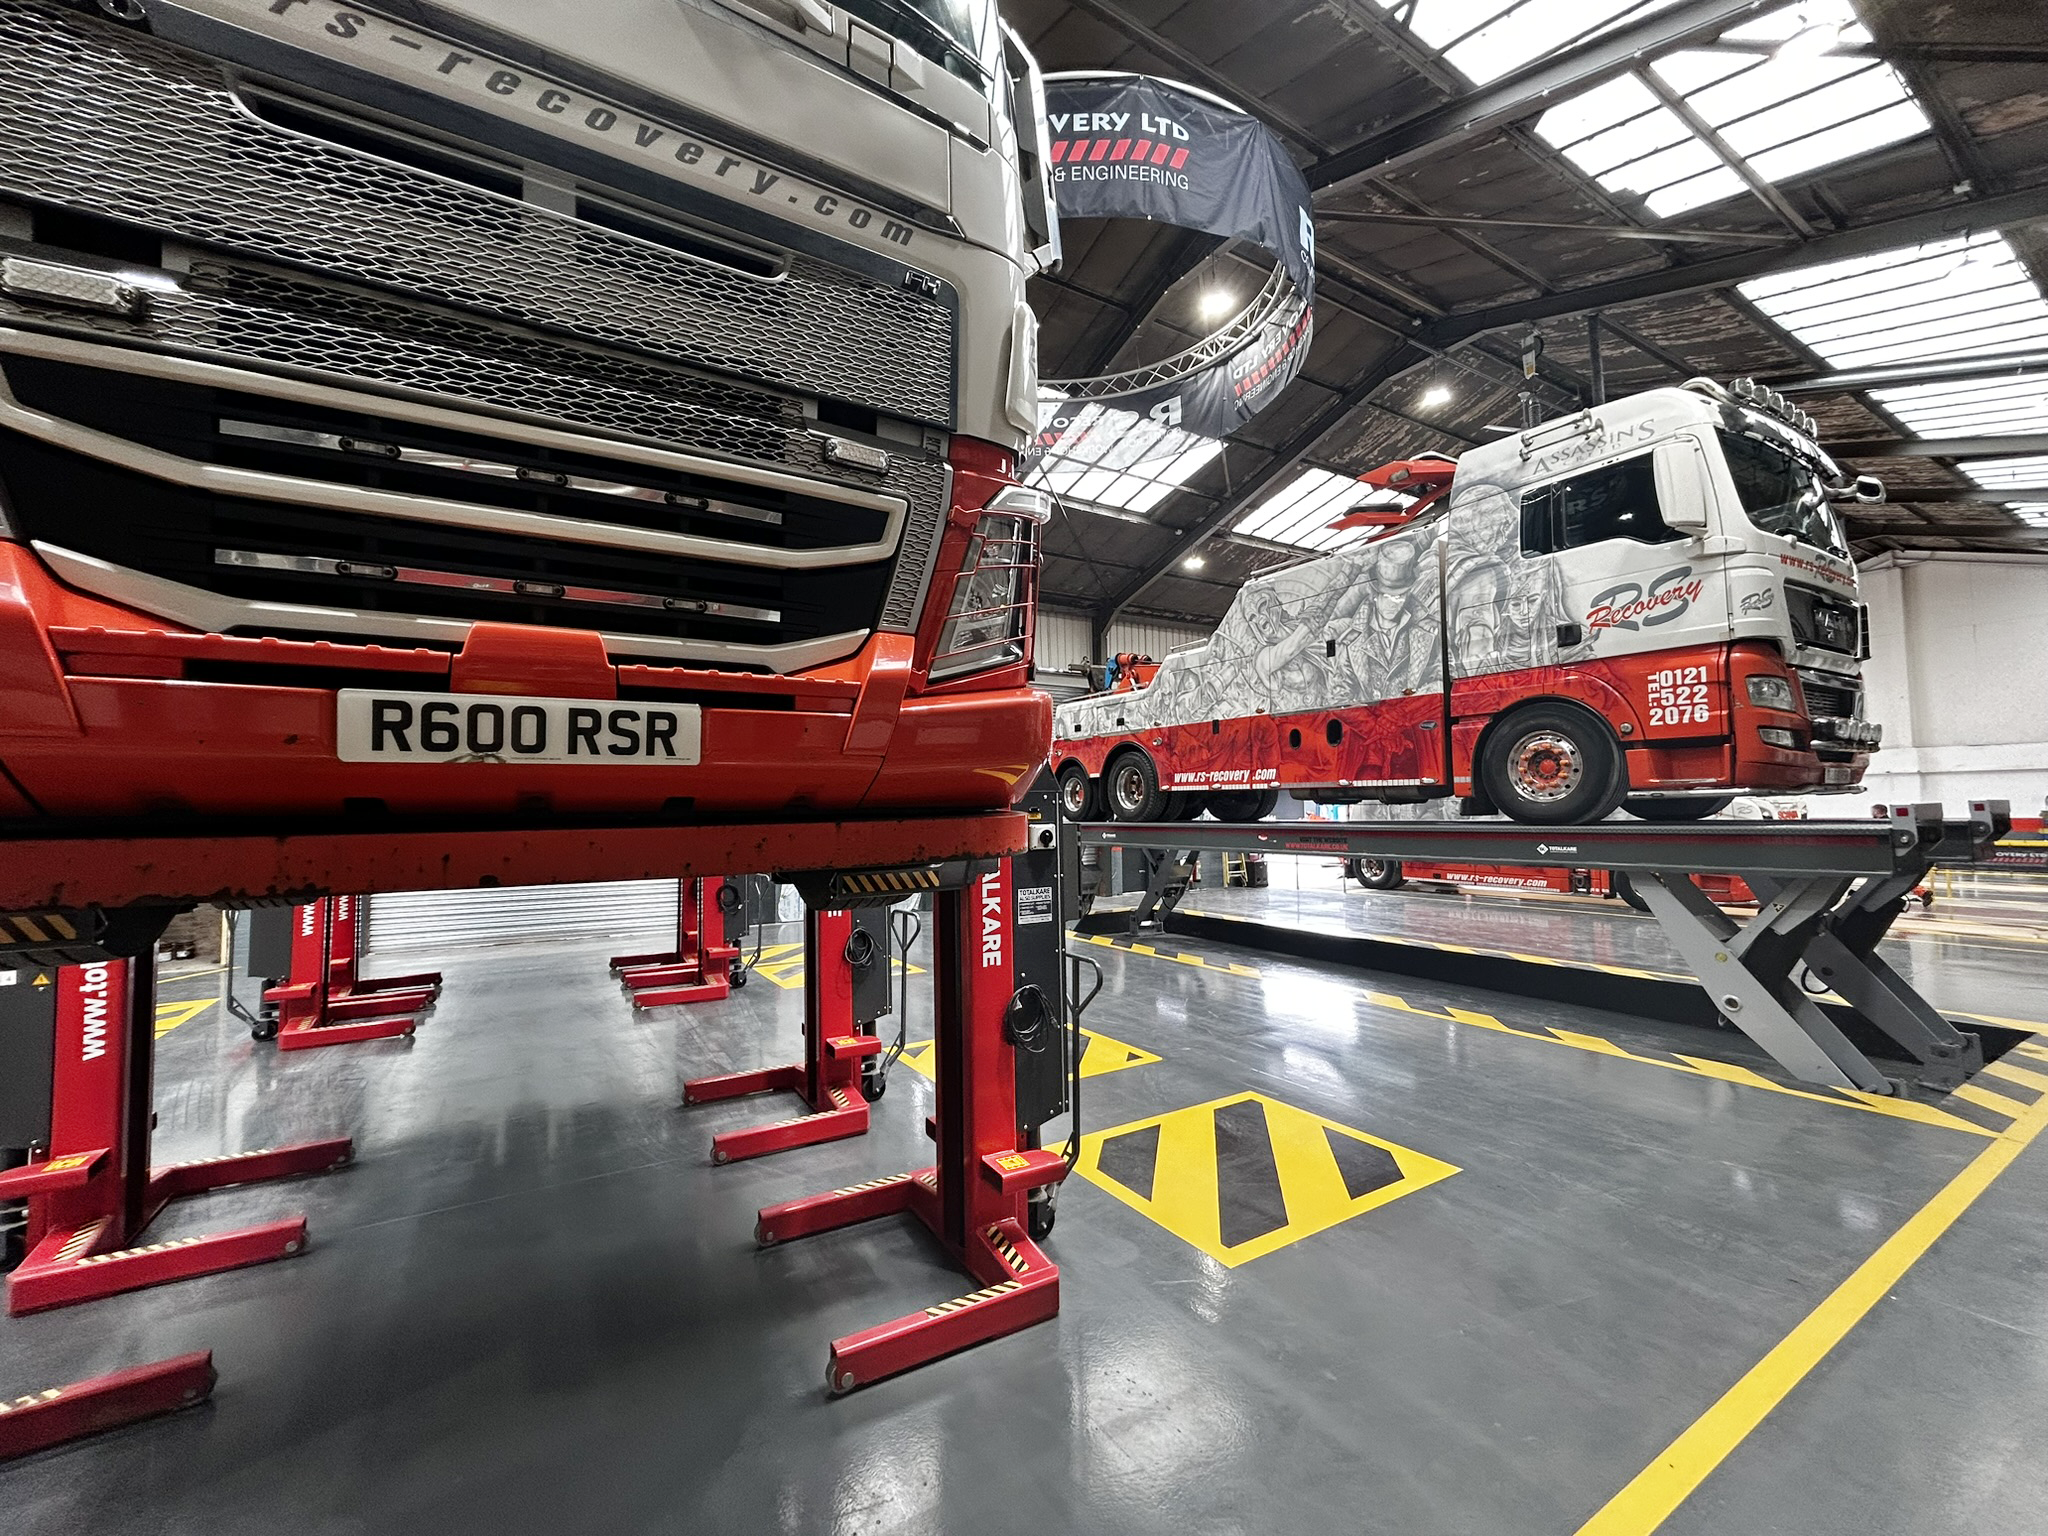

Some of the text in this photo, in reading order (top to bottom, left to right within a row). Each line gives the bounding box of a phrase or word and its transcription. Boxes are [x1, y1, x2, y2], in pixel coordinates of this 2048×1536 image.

[1141, 112, 1190, 141] LTD
[1054, 164, 1189, 190] & ENGINEERING
[905, 270, 941, 295] FH
[1586, 580, 1704, 635] Recovery
[1648, 672, 1660, 707] TEL:
[1660, 667, 1707, 688] 0121
[1660, 685, 1708, 706] 522
[1650, 704, 1709, 726] 2076
[372, 699, 677, 757] R600 RSR
[1446, 871, 1548, 888] www.rs-recovery.com
